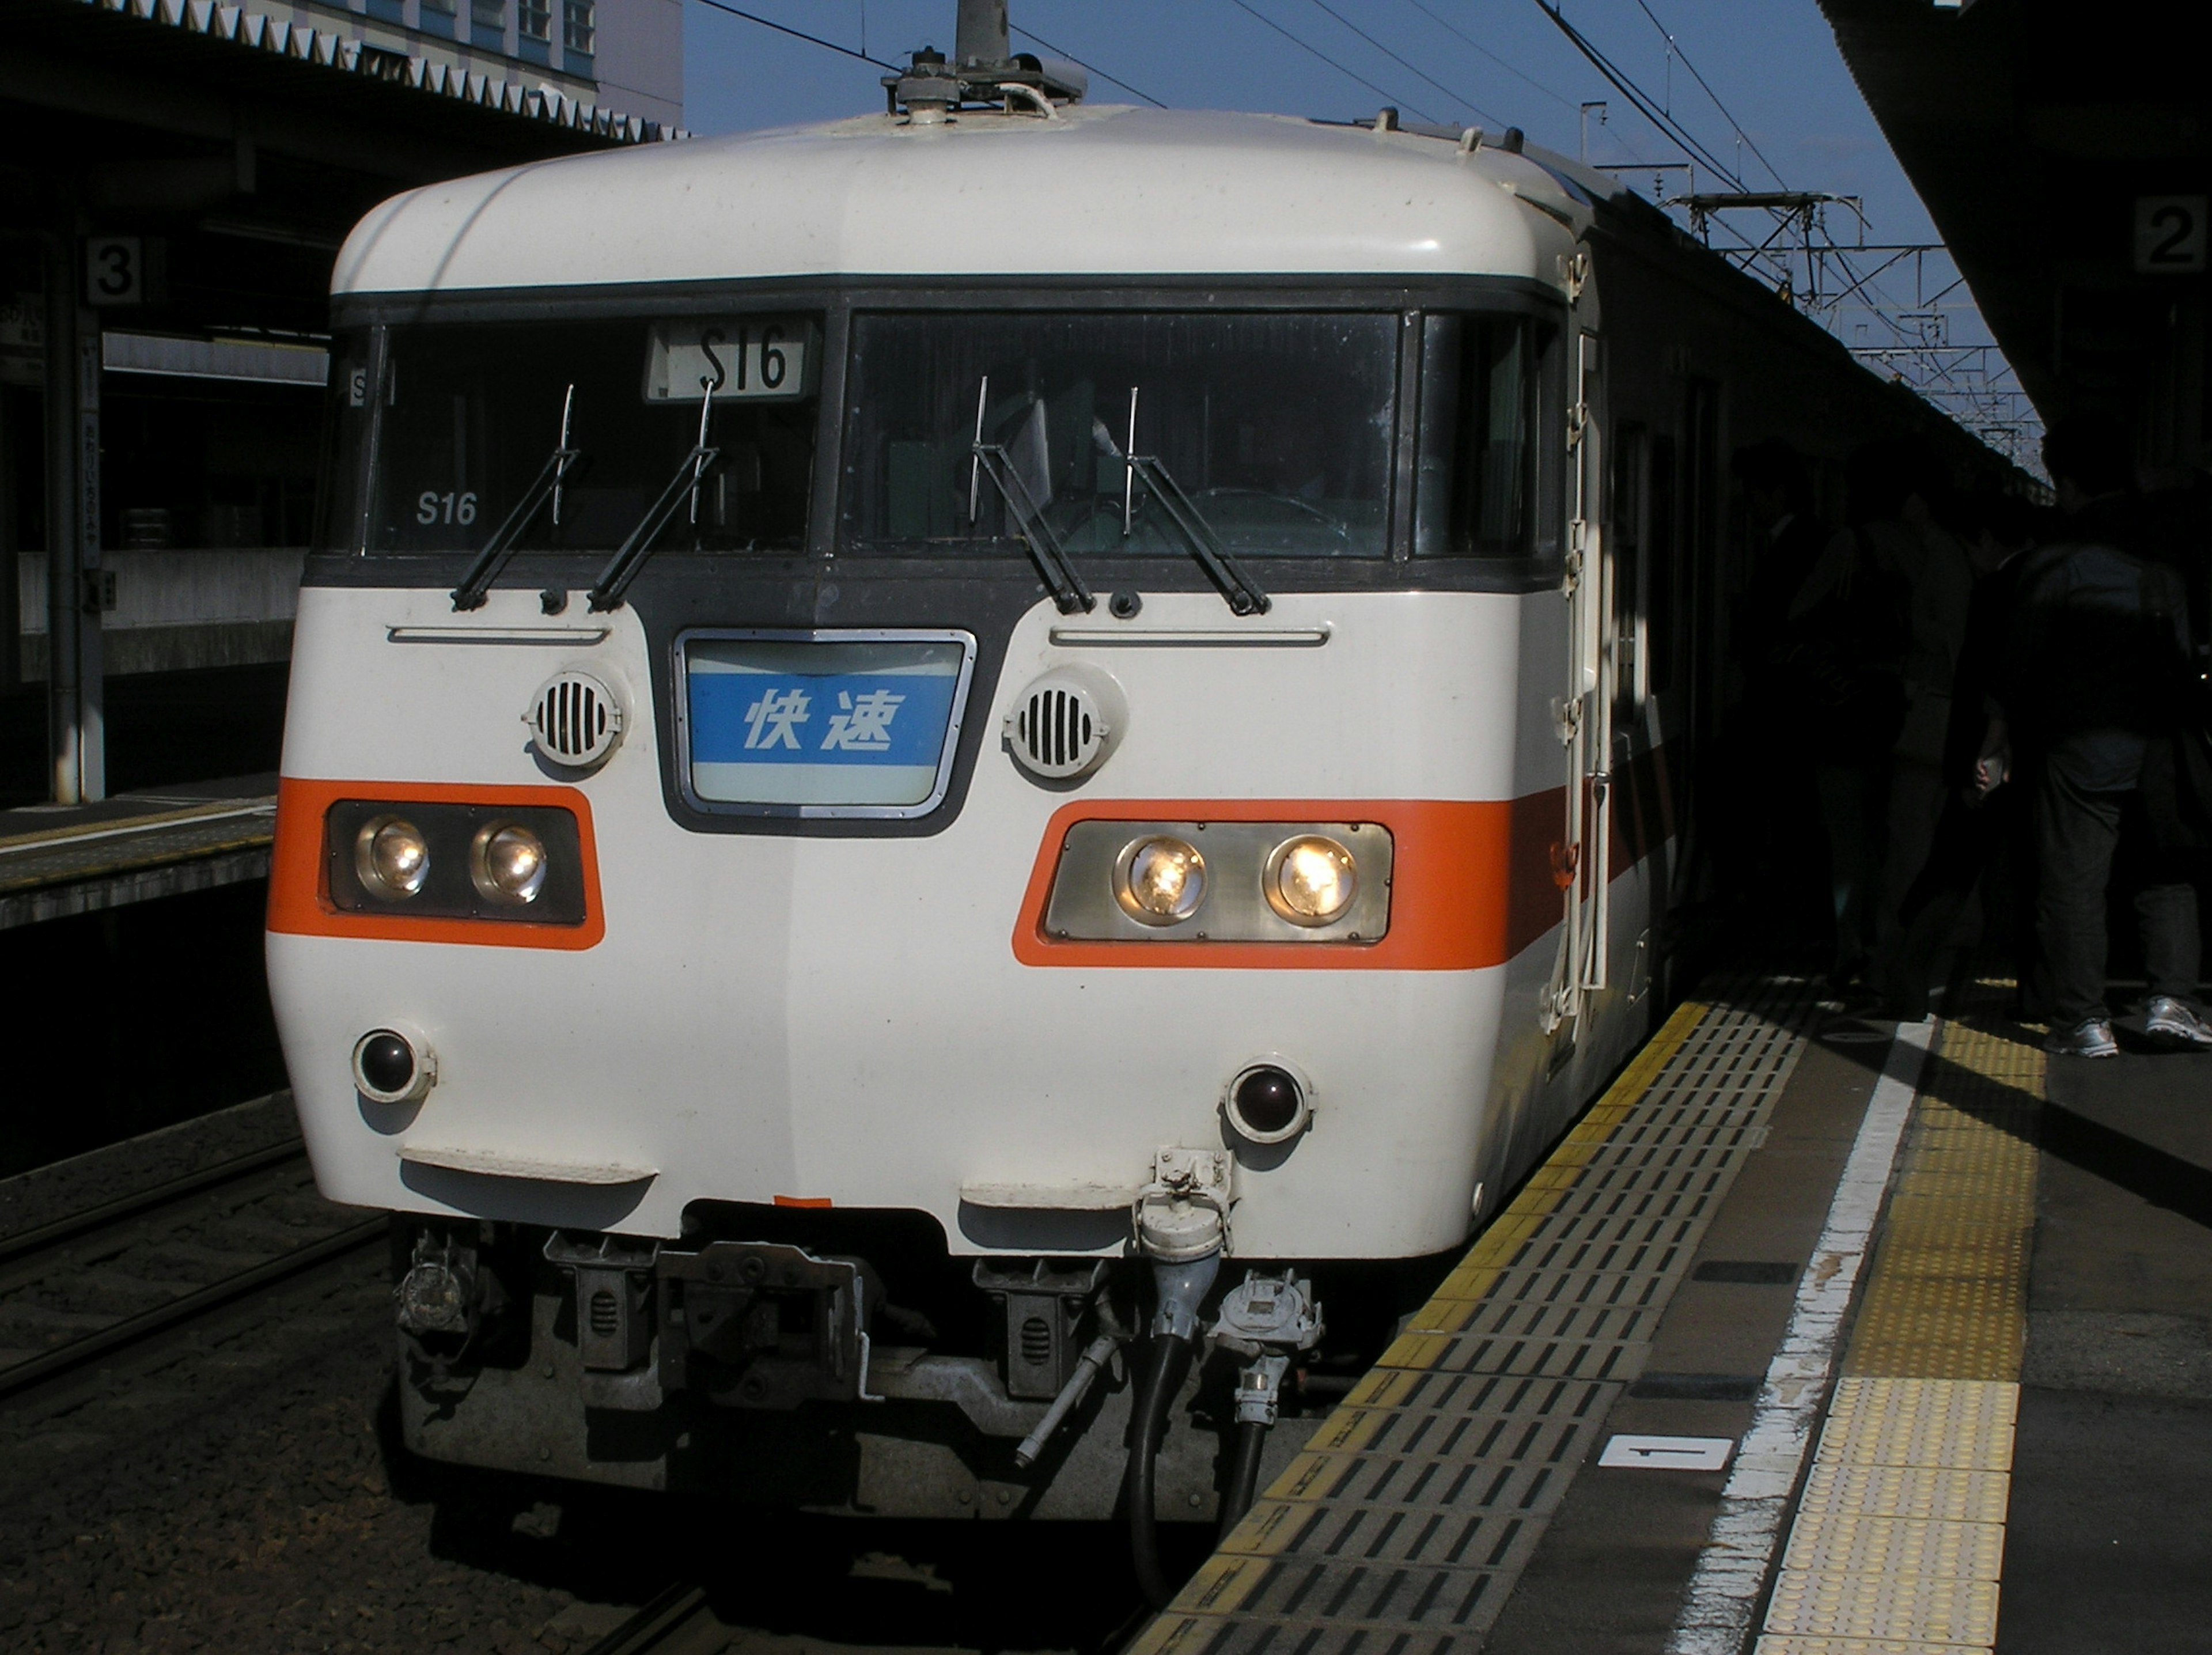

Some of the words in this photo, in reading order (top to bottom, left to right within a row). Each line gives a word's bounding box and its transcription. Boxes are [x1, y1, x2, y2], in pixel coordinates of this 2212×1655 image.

[2150, 206, 2192, 262] 2
[99, 245, 130, 294] 3
[700, 324, 786, 391] S16
[416, 491, 478, 525] S16
[744, 688, 906, 751] 快速
